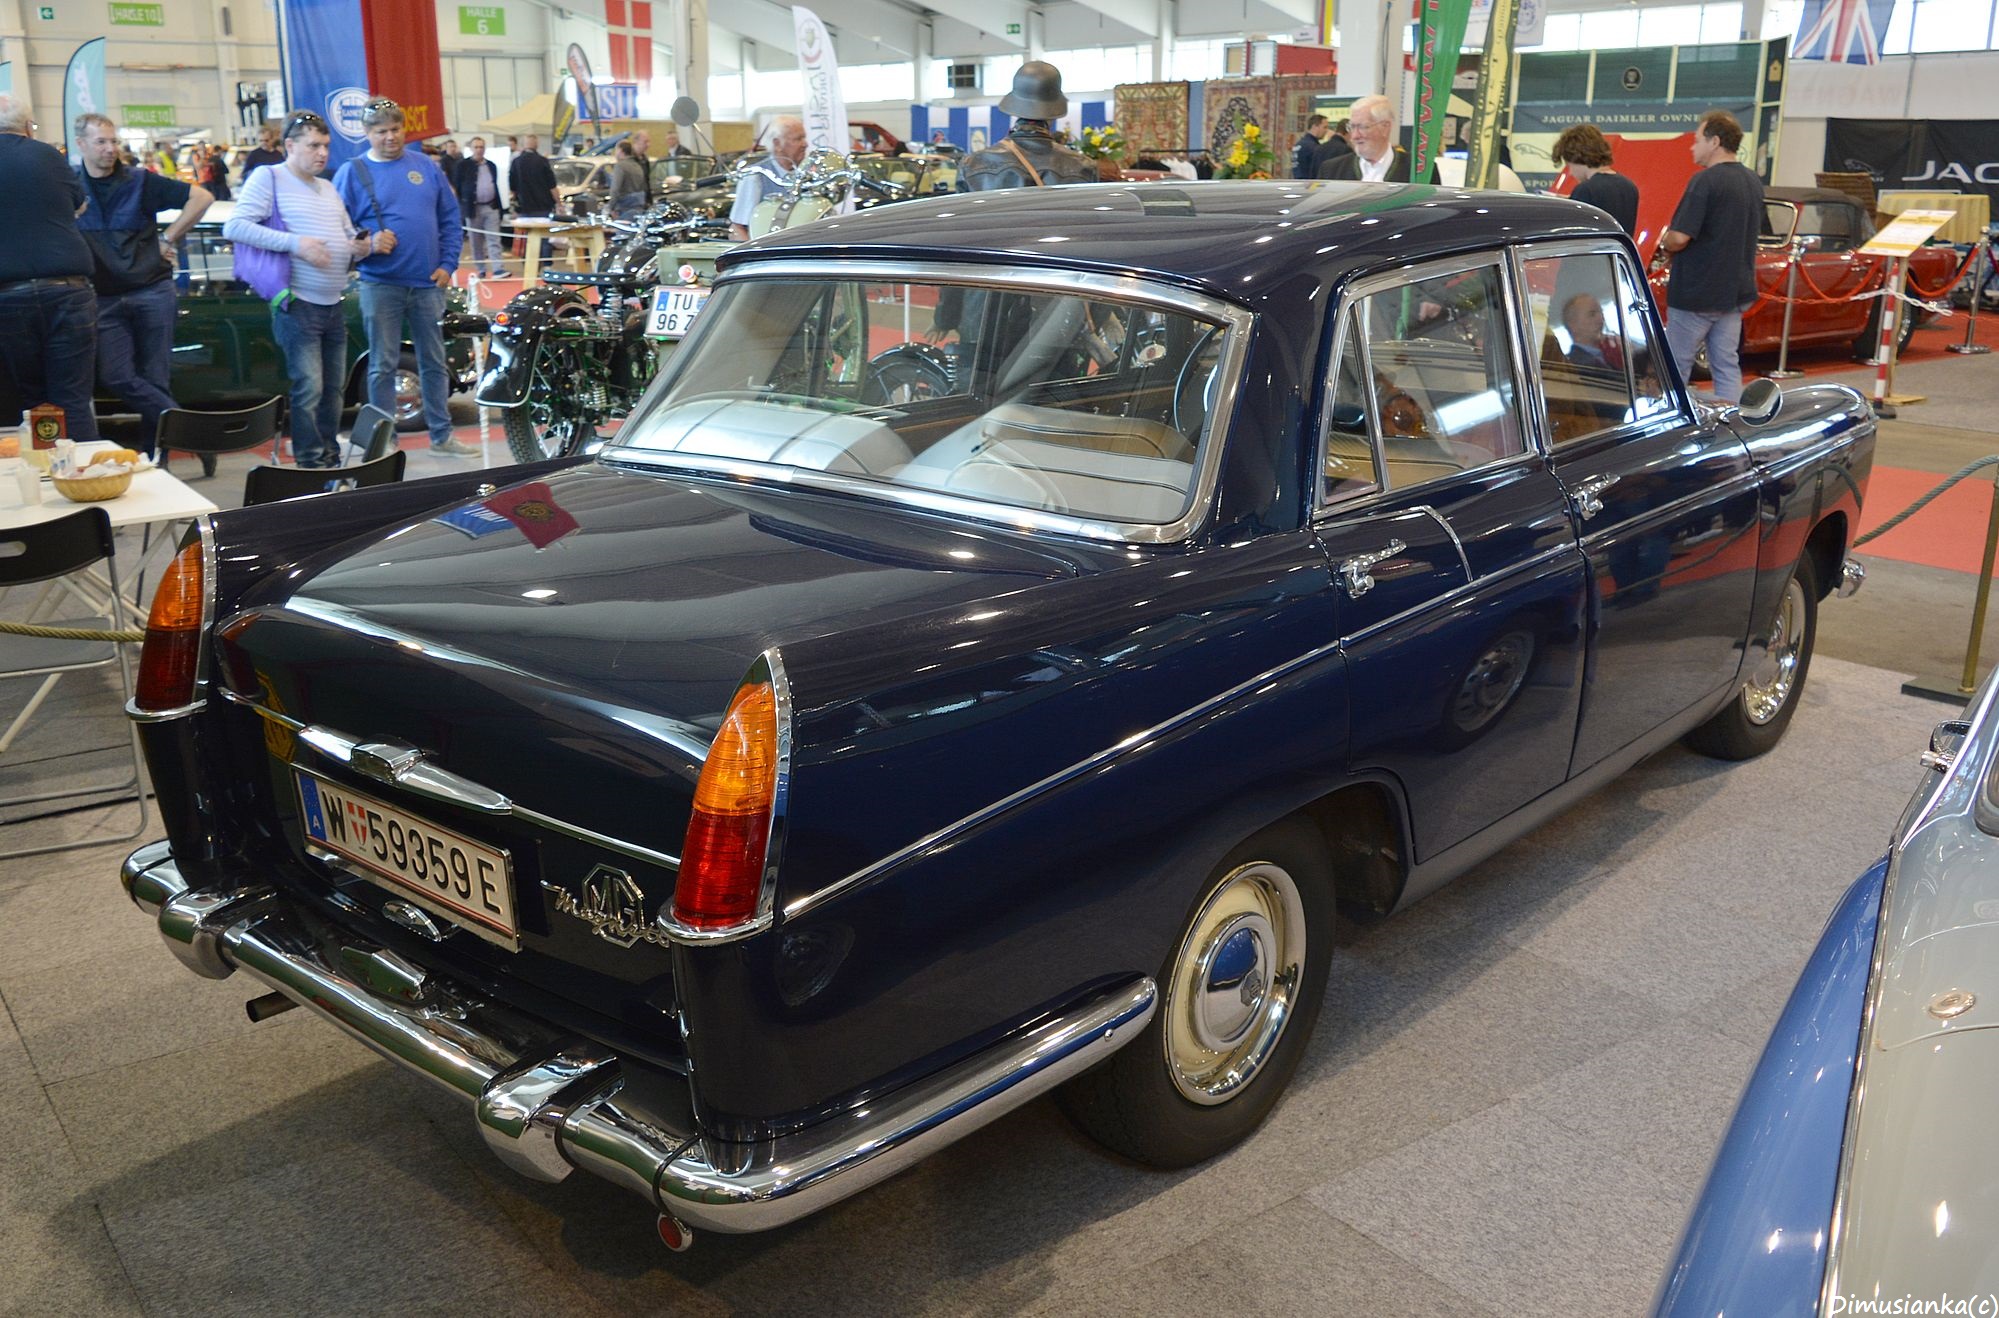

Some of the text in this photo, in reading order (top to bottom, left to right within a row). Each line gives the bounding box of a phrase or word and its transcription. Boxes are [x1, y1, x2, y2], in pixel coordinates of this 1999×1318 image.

[466, 7, 497, 18] HALLE
[477, 19, 489, 34] 6
[1541, 114, 1592, 123] JAGUAR
[1596, 113, 1656, 123] DAIMLER
[674, 293, 694, 310] TU
[656, 313, 678, 331] 96
[312, 814, 321, 829] A
[322, 791, 501, 914] W 59359 E
